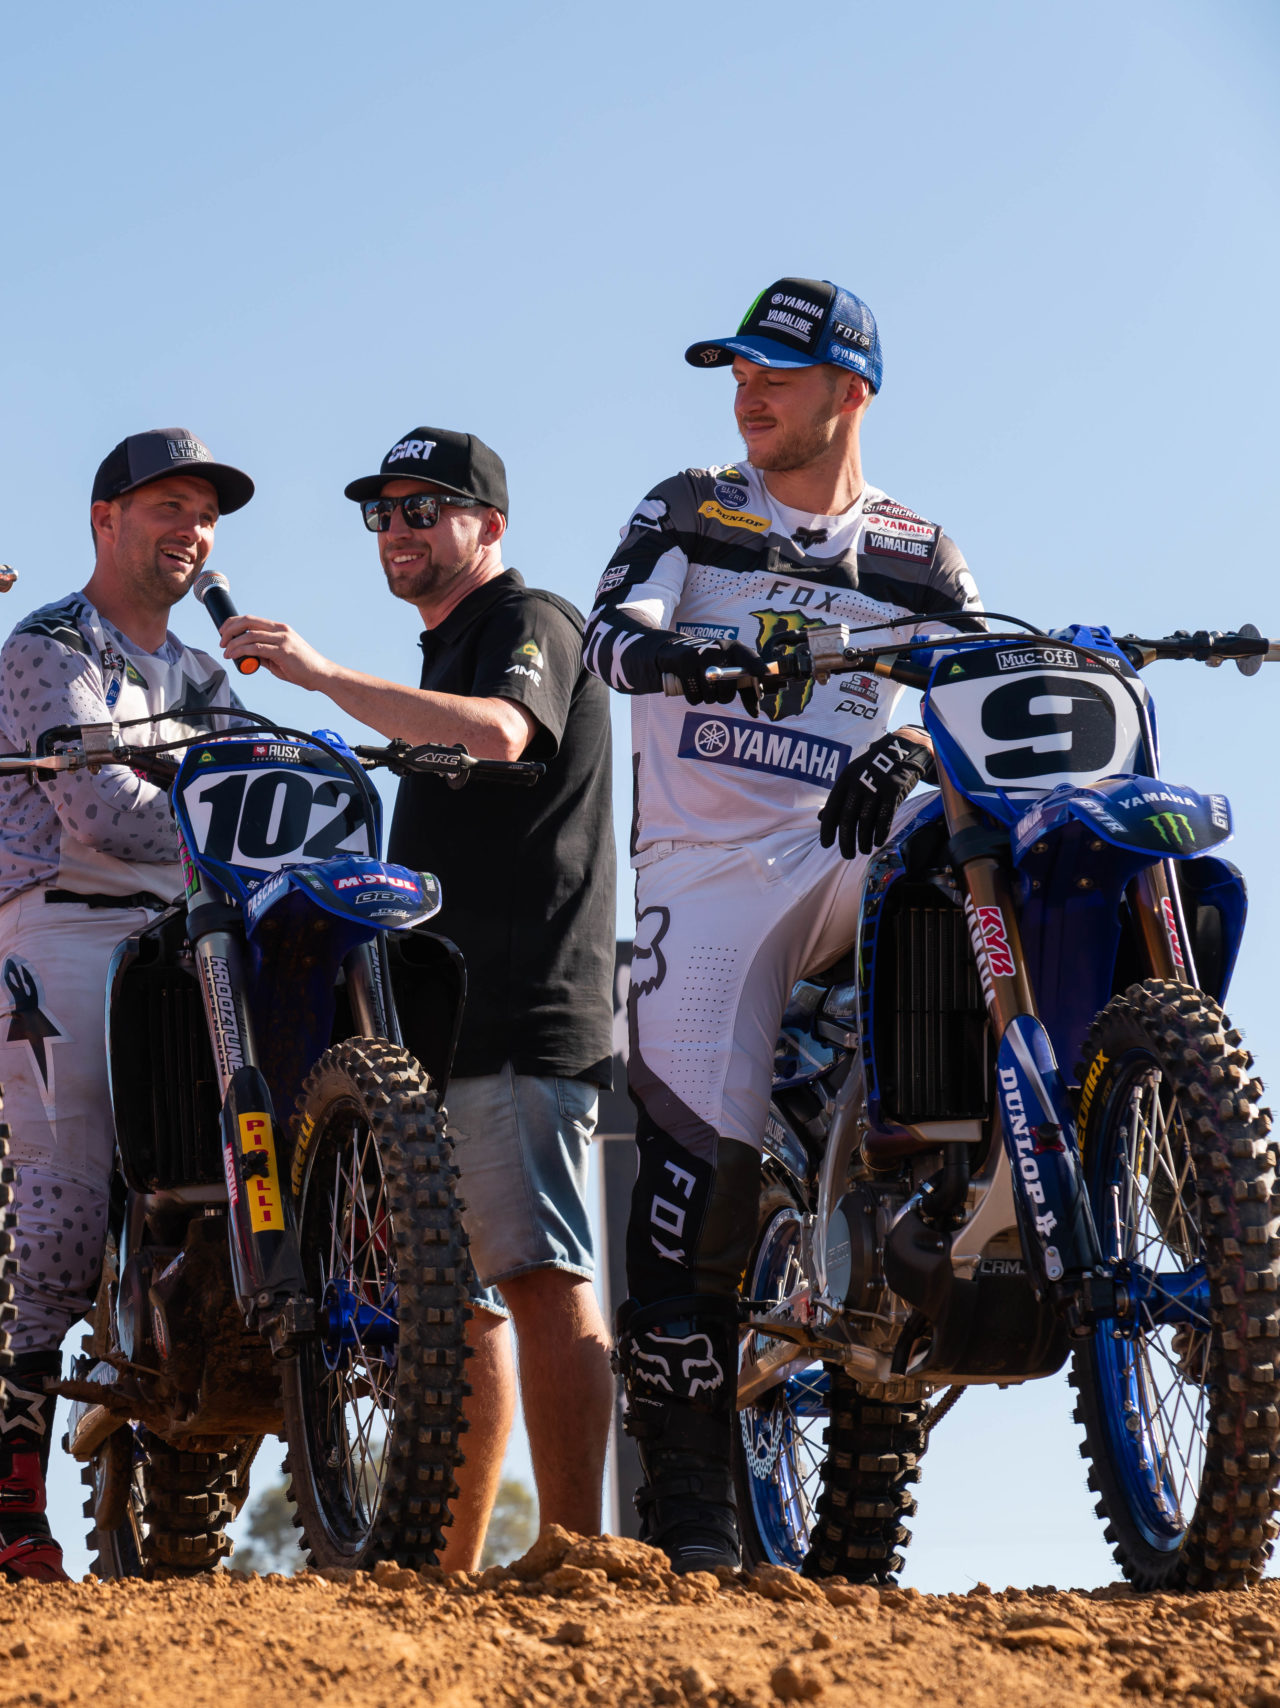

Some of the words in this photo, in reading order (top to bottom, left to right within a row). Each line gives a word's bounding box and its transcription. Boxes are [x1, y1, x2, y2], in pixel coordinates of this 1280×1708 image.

[782, 295, 824, 319] YAMAHA
[767, 308, 813, 335] YAMALUBE
[835, 323, 859, 342] FOX
[840, 345, 866, 368] YAMAHA
[387, 439, 437, 464] DIRT
[716, 507, 764, 528] DUNLOP
[863, 504, 932, 524] SUPERCRO
[882, 519, 934, 535] YAMAHA
[870, 533, 929, 558] YAMALUBE
[766, 580, 842, 614] FOX
[1000, 650, 1074, 668] Muc-Off
[833, 699, 879, 720] pod
[981, 675, 1117, 780] 9
[415, 752, 461, 766] ARC
[733, 725, 841, 783] YAMAHA
[859, 739, 910, 793] FOX
[1118, 791, 1198, 810] YAMAHA
[1211, 794, 1229, 831] GYTR
[198, 769, 365, 862] 102
[1079, 799, 1129, 834] GYTR
[337, 874, 417, 891] MOTUL
[976, 906, 1016, 977] KYB
[202, 956, 228, 1077] SUSPENSION
[209, 955, 244, 1075] KROOZTUNE
[998, 1066, 1046, 1205] DUNLOP
[246, 1118, 272, 1223] PILLI
[650, 1159, 697, 1270] FOX
